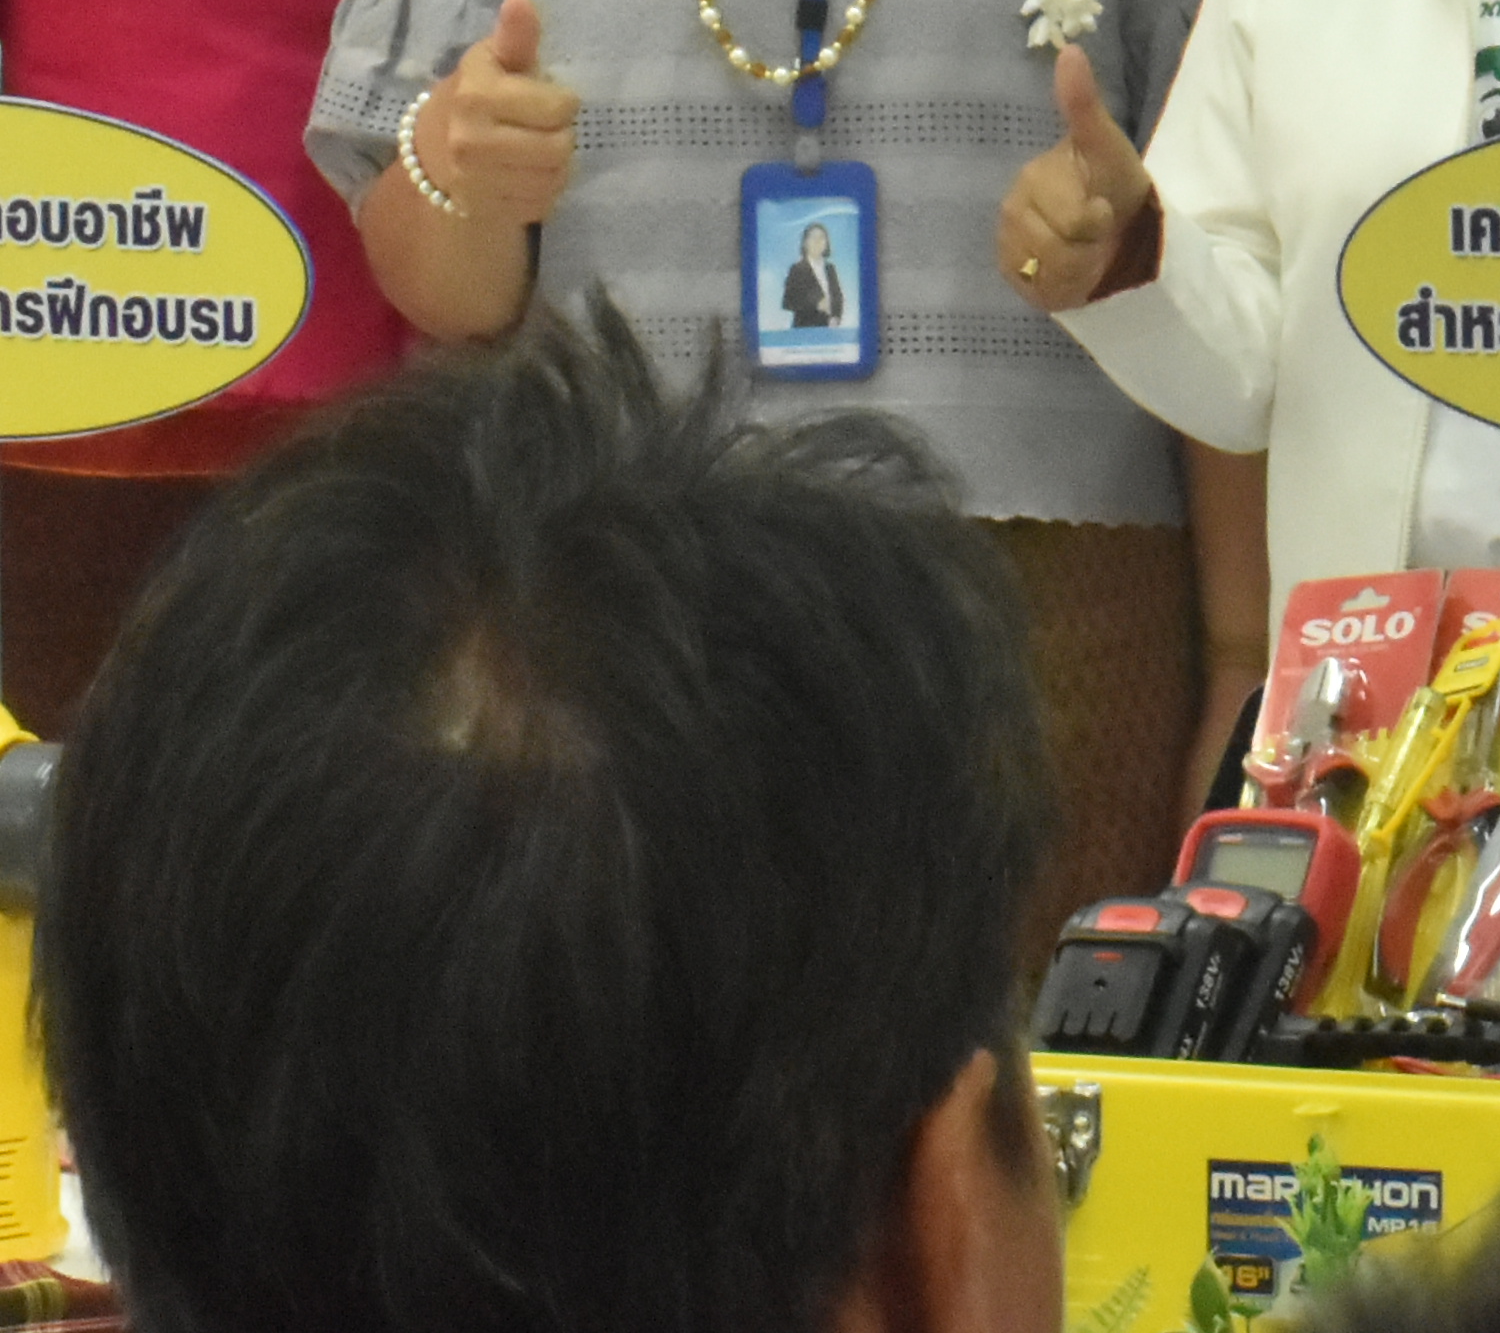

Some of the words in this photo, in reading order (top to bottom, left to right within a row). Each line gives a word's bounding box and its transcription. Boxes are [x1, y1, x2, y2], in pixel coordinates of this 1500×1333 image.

[0, 188, 205, 249] อบอาชีพ
[1299, 610, 1416, 647] SOLO
